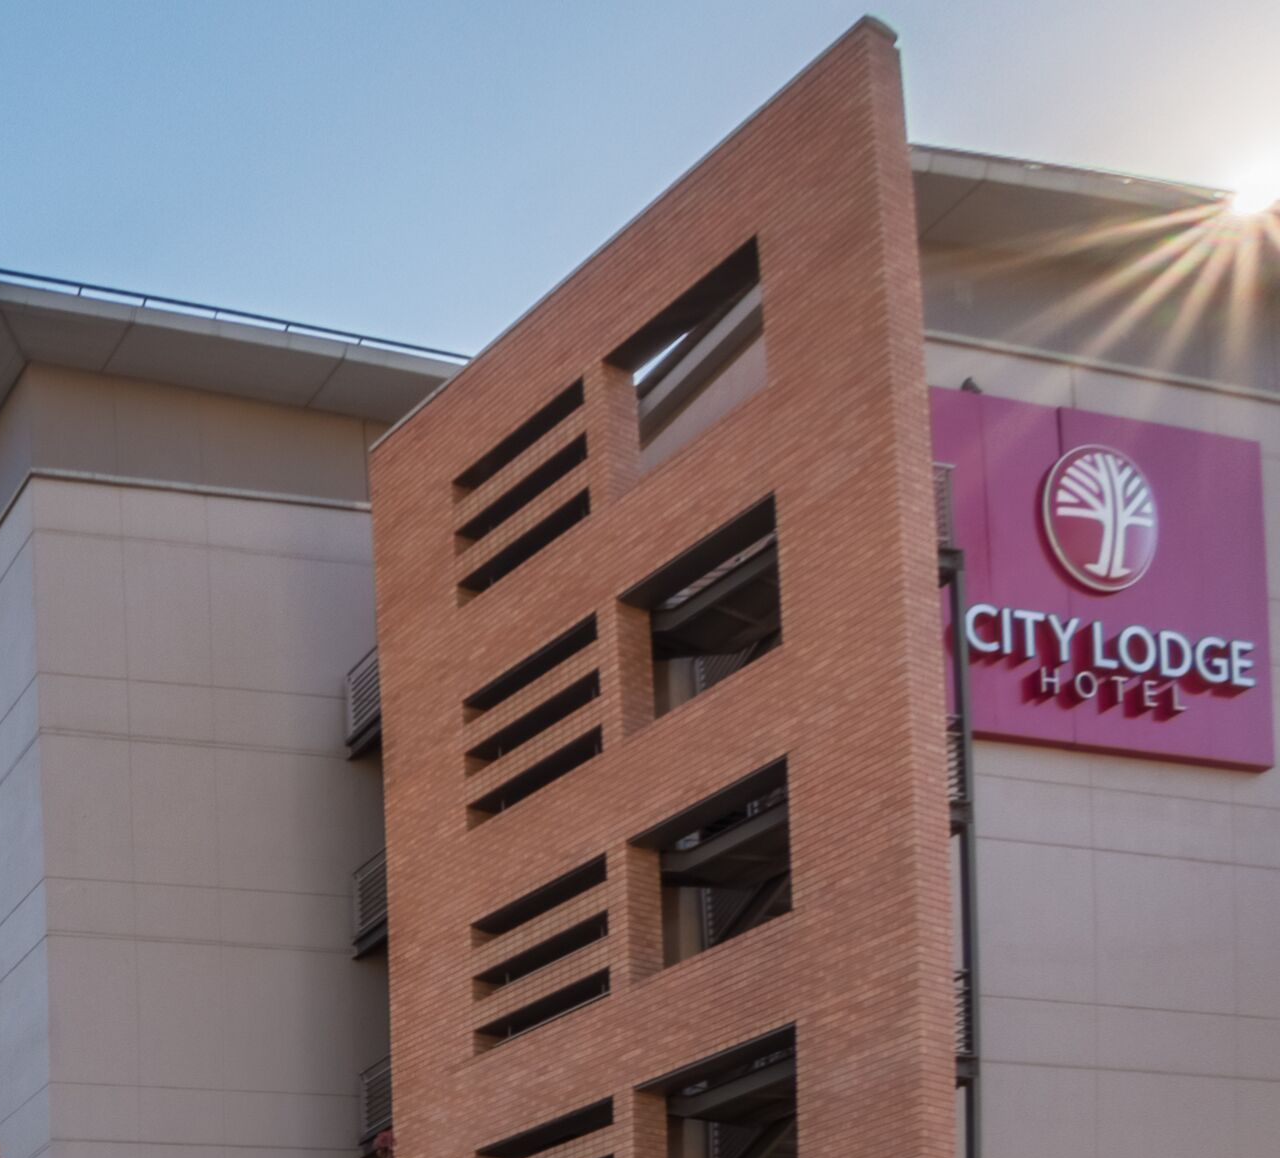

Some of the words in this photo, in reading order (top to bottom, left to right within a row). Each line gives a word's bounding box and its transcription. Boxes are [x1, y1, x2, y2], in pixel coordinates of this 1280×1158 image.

[964, 603, 1080, 662] CITY
[1092, 621, 1255, 687] LODGE
[1040, 667, 1187, 711] HOTEL
